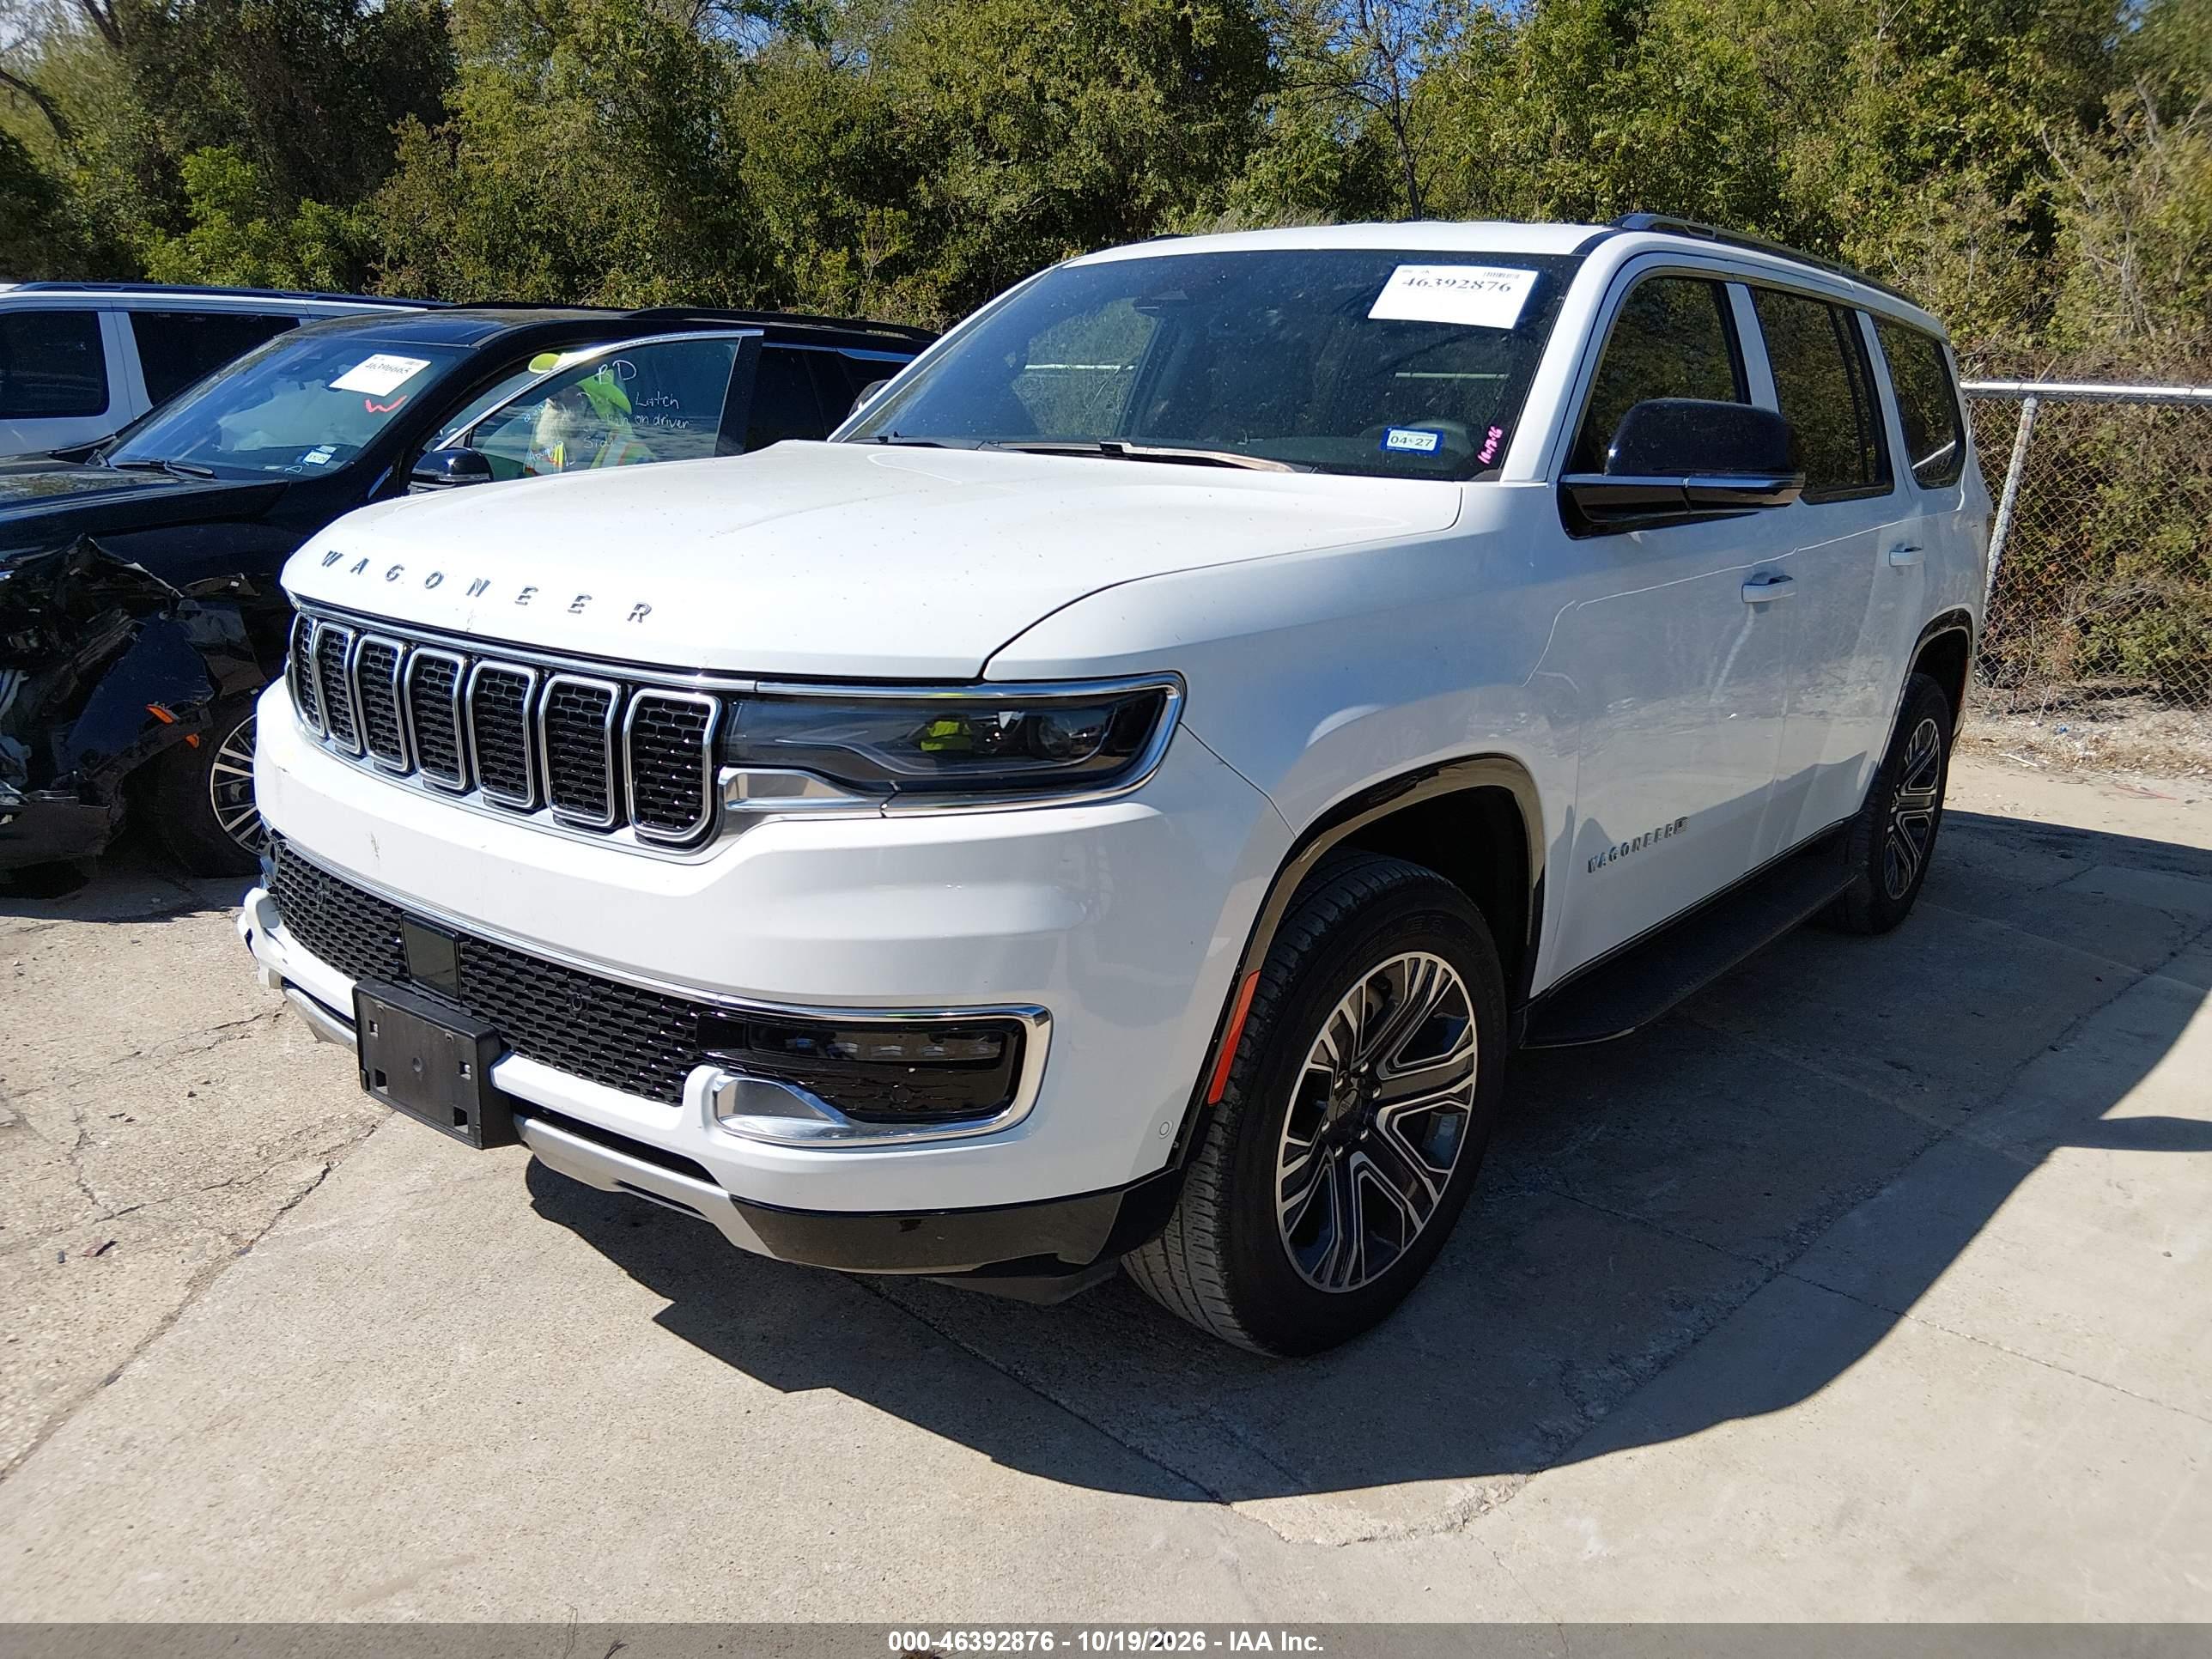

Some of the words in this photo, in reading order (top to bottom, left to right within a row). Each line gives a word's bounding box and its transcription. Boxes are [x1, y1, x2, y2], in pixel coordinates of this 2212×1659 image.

[1401, 276, 1512, 293] 46392876
[635, 391, 679, 410] Latch
[635, 415, 649, 426] on
[653, 414, 690, 428] driver
[320, 550, 653, 623] WAGONEER
[1587, 823, 1674, 873] WAGONEER
